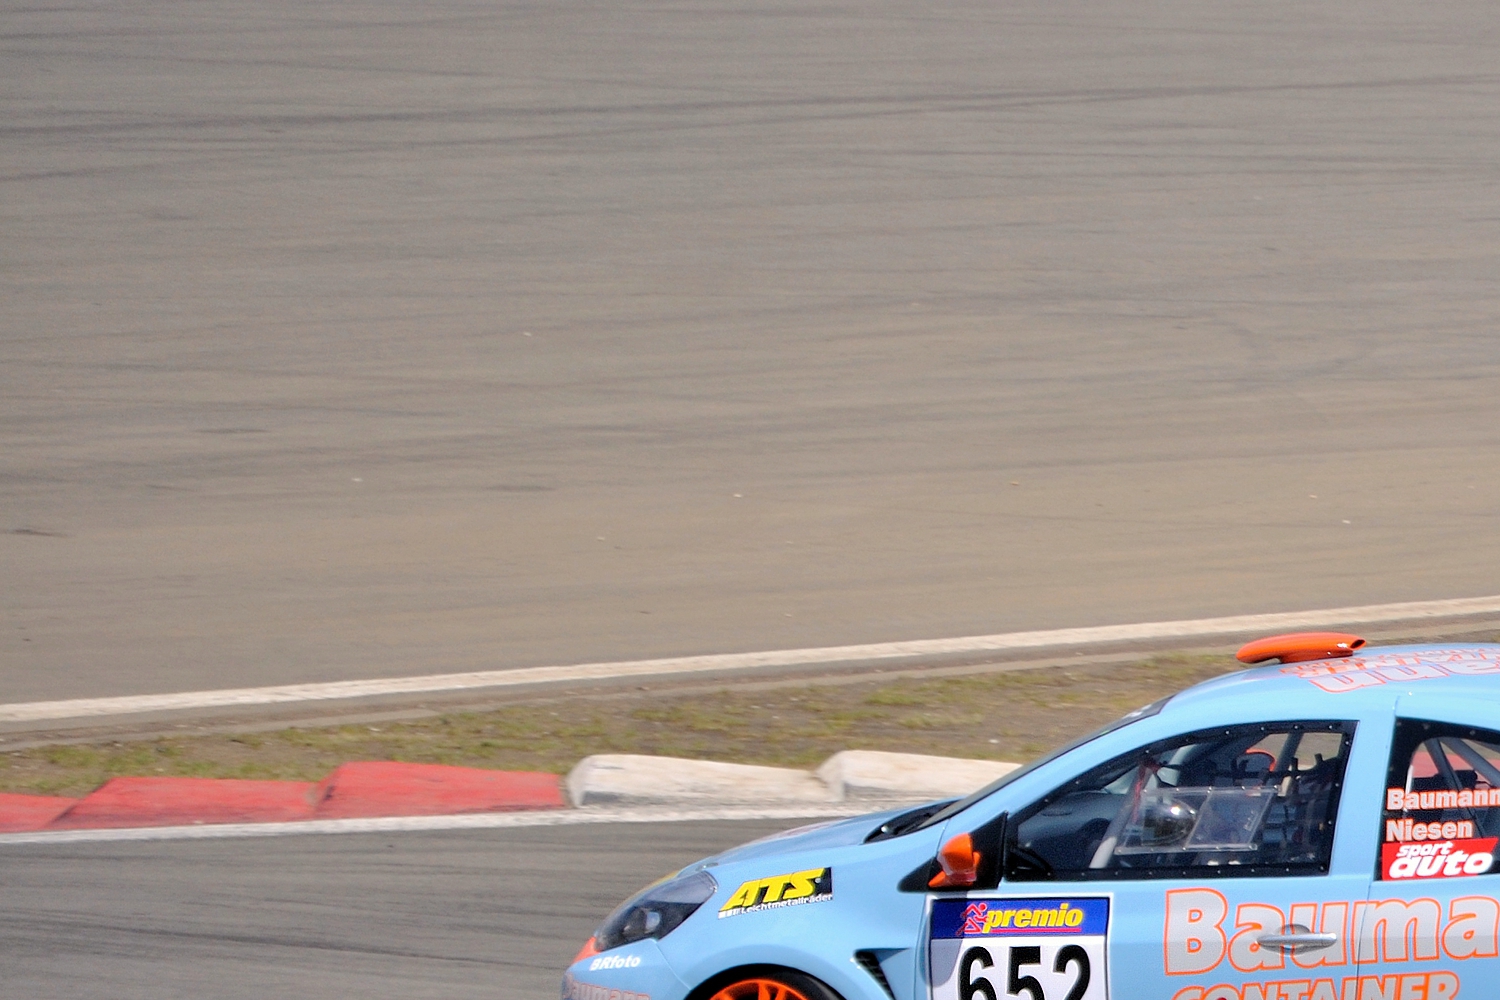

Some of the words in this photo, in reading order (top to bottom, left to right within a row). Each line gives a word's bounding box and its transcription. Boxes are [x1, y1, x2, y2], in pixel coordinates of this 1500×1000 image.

[1385, 818, 1474, 842] Niesen
[1396, 841, 1454, 859] sport
[1389, 850, 1494, 879] auto
[719, 867, 825, 912] ATS
[981, 903, 1084, 934] premio
[589, 955, 641, 972] BRfoto
